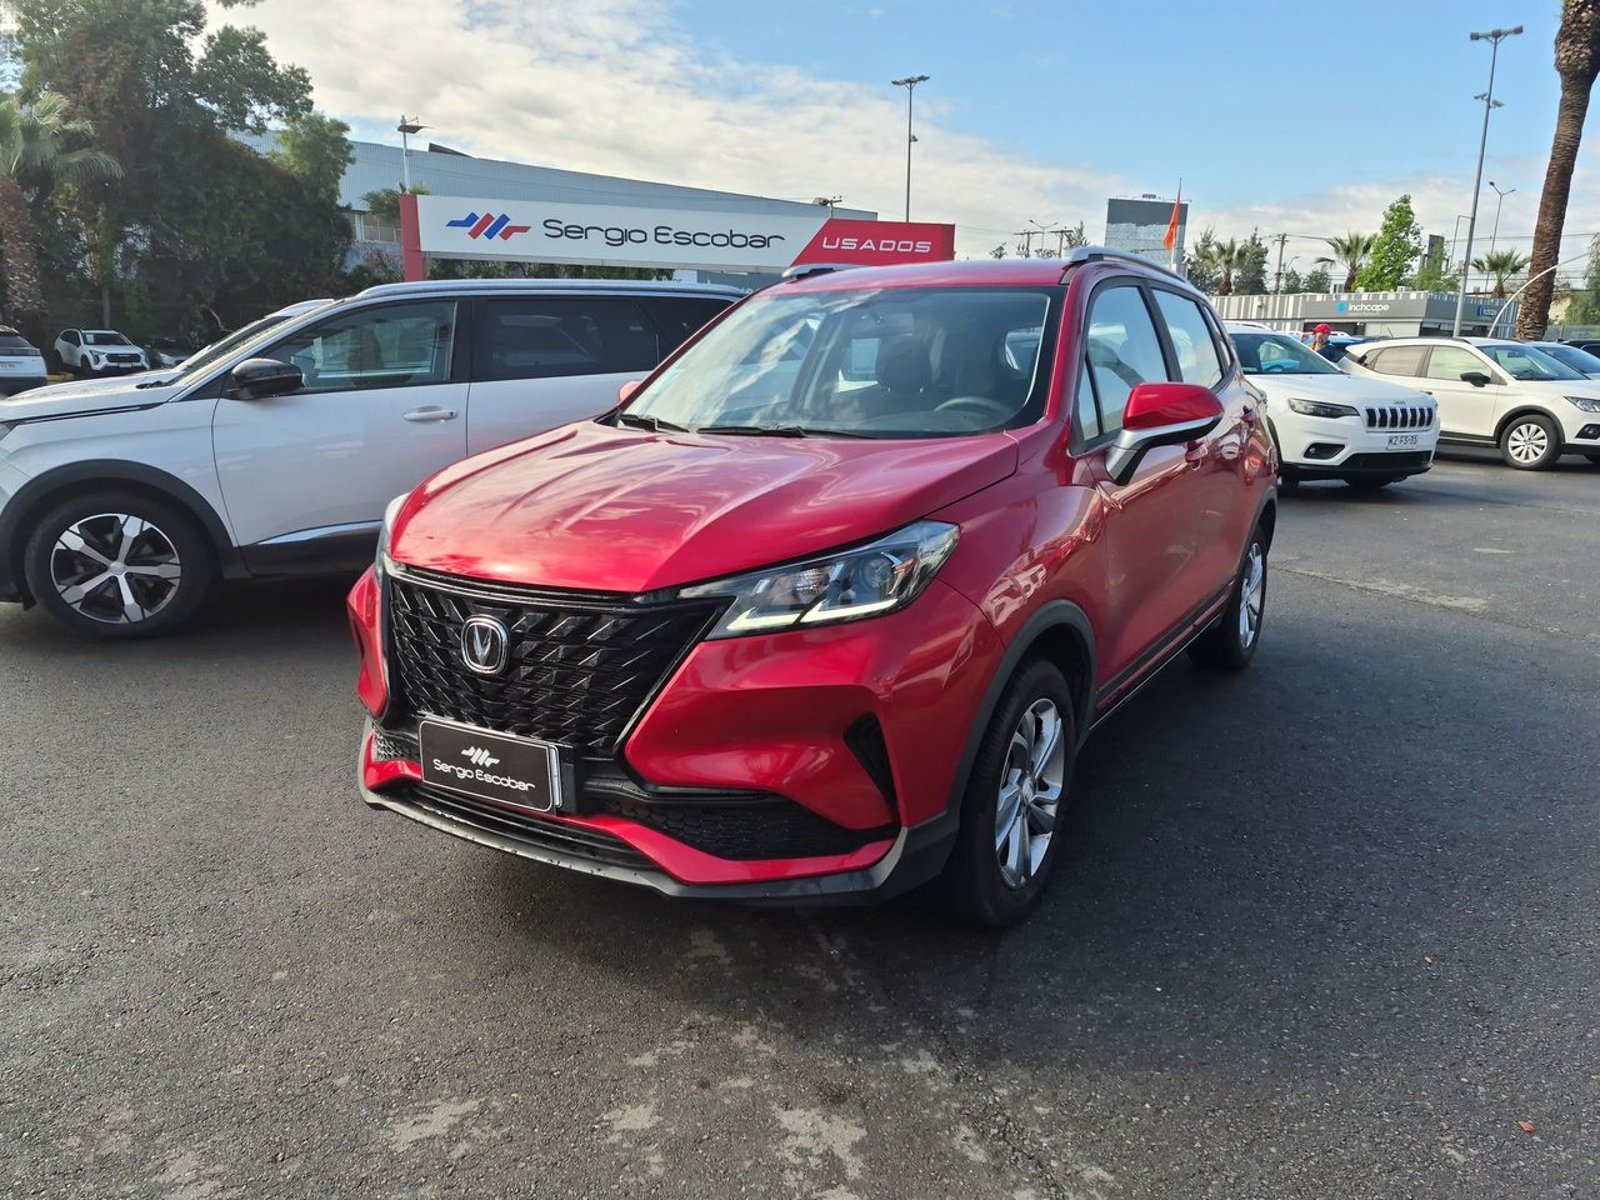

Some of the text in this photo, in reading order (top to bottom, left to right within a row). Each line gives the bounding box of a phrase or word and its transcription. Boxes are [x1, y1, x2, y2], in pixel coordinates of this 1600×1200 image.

[543, 218, 785, 249] Sergio Escobar
[822, 236, 932, 253] USADOS
[475, 769, 536, 792] Escobar
